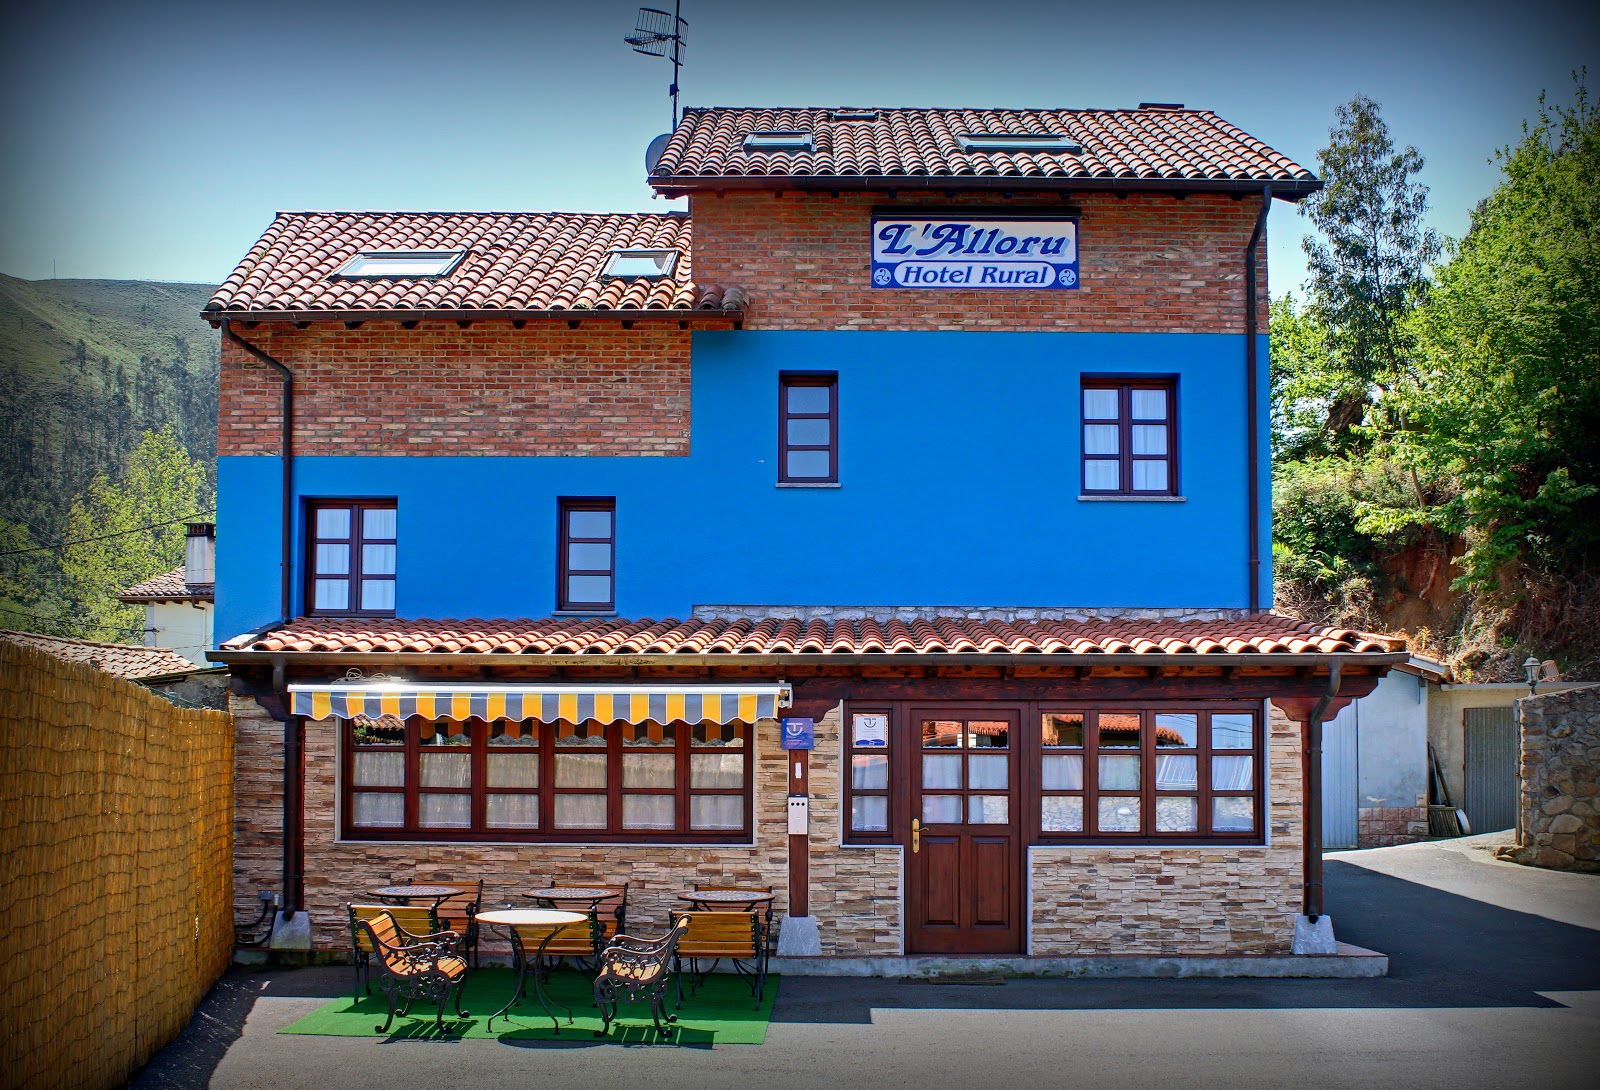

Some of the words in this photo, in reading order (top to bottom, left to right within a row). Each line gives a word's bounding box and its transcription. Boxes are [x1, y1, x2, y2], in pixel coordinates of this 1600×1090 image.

[878, 223, 1067, 256] L'Alloru
[901, 266, 971, 284] Hotel
[980, 266, 1048, 284] Rural
